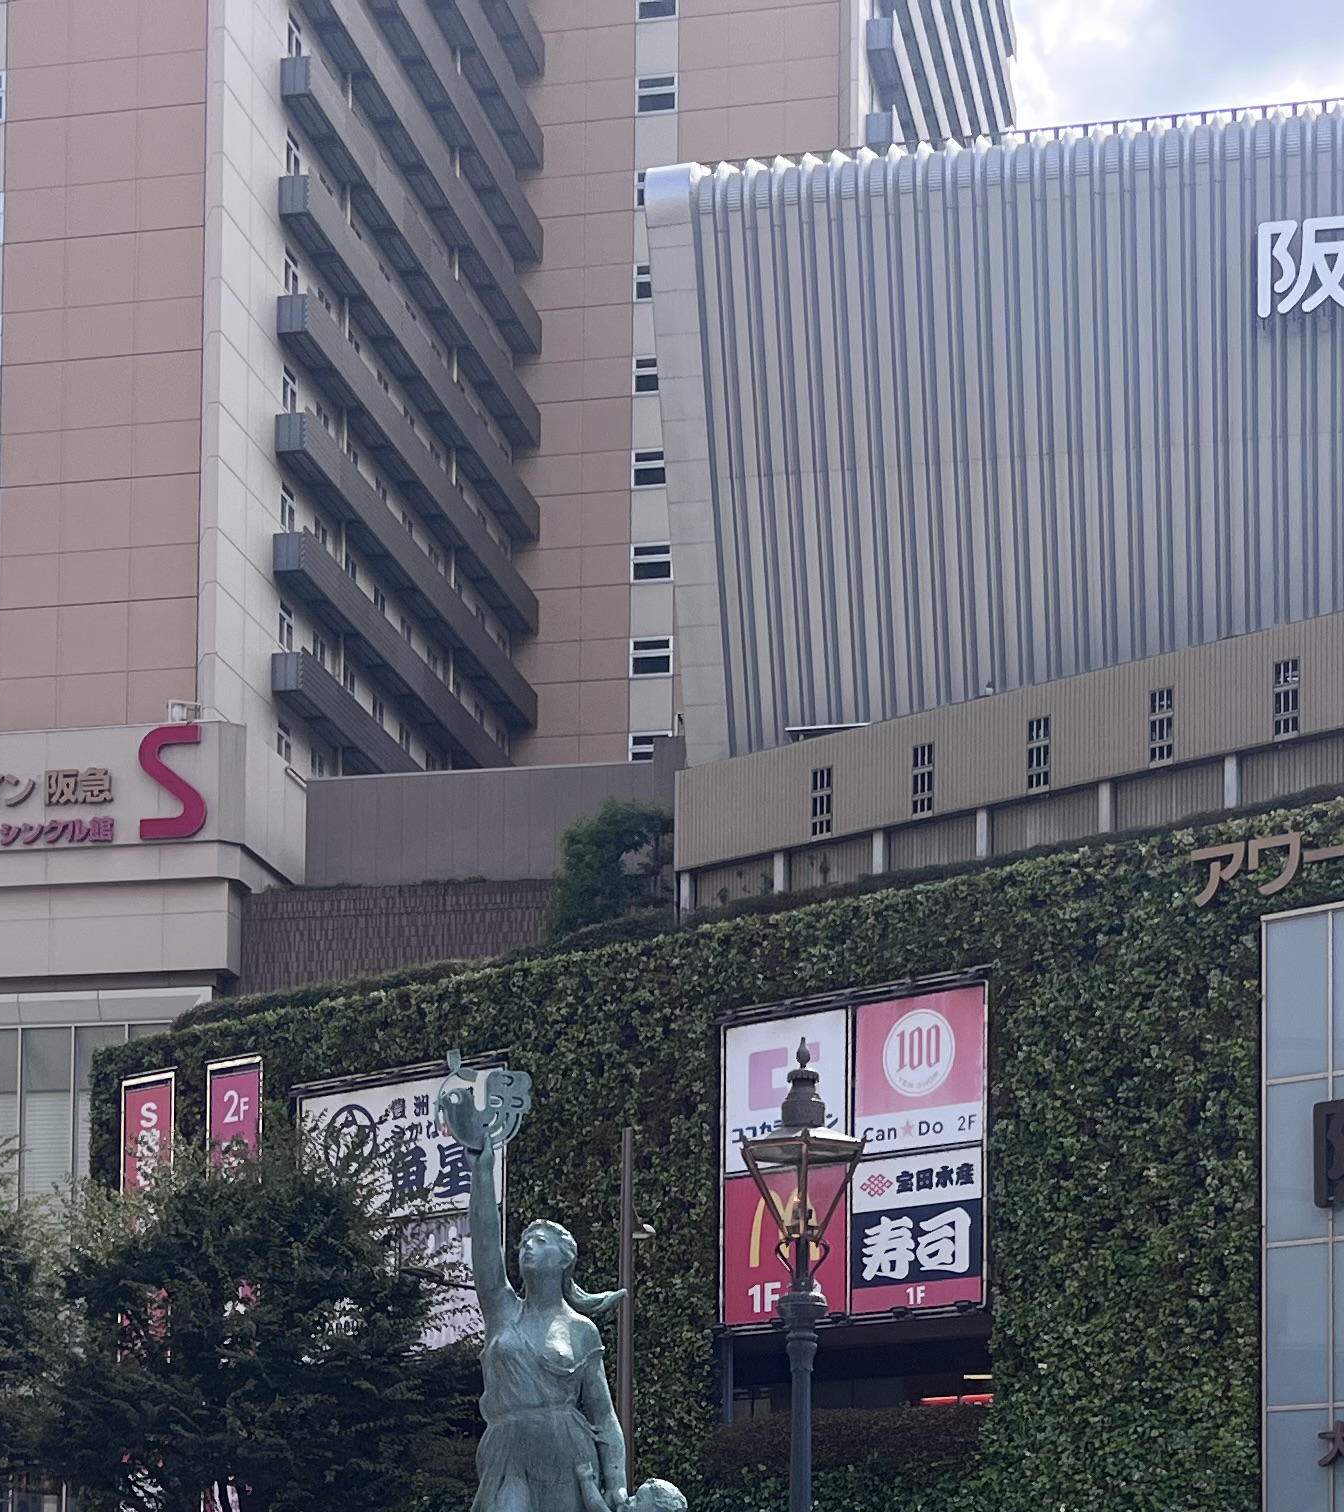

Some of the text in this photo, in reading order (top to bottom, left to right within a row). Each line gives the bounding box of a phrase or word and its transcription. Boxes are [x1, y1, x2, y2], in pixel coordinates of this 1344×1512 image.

[44, 767, 114, 807] 阪急
[138, 724, 208, 840] S
[0, 815, 115, 847] シングル館
[895, 1023, 942, 1073] 100
[223, 1089, 249, 1124] 2F
[957, 1114, 977, 1132] 2F
[861, 1206, 972, 1281] 寿司
[905, 1284, 927, 1306] 1F
